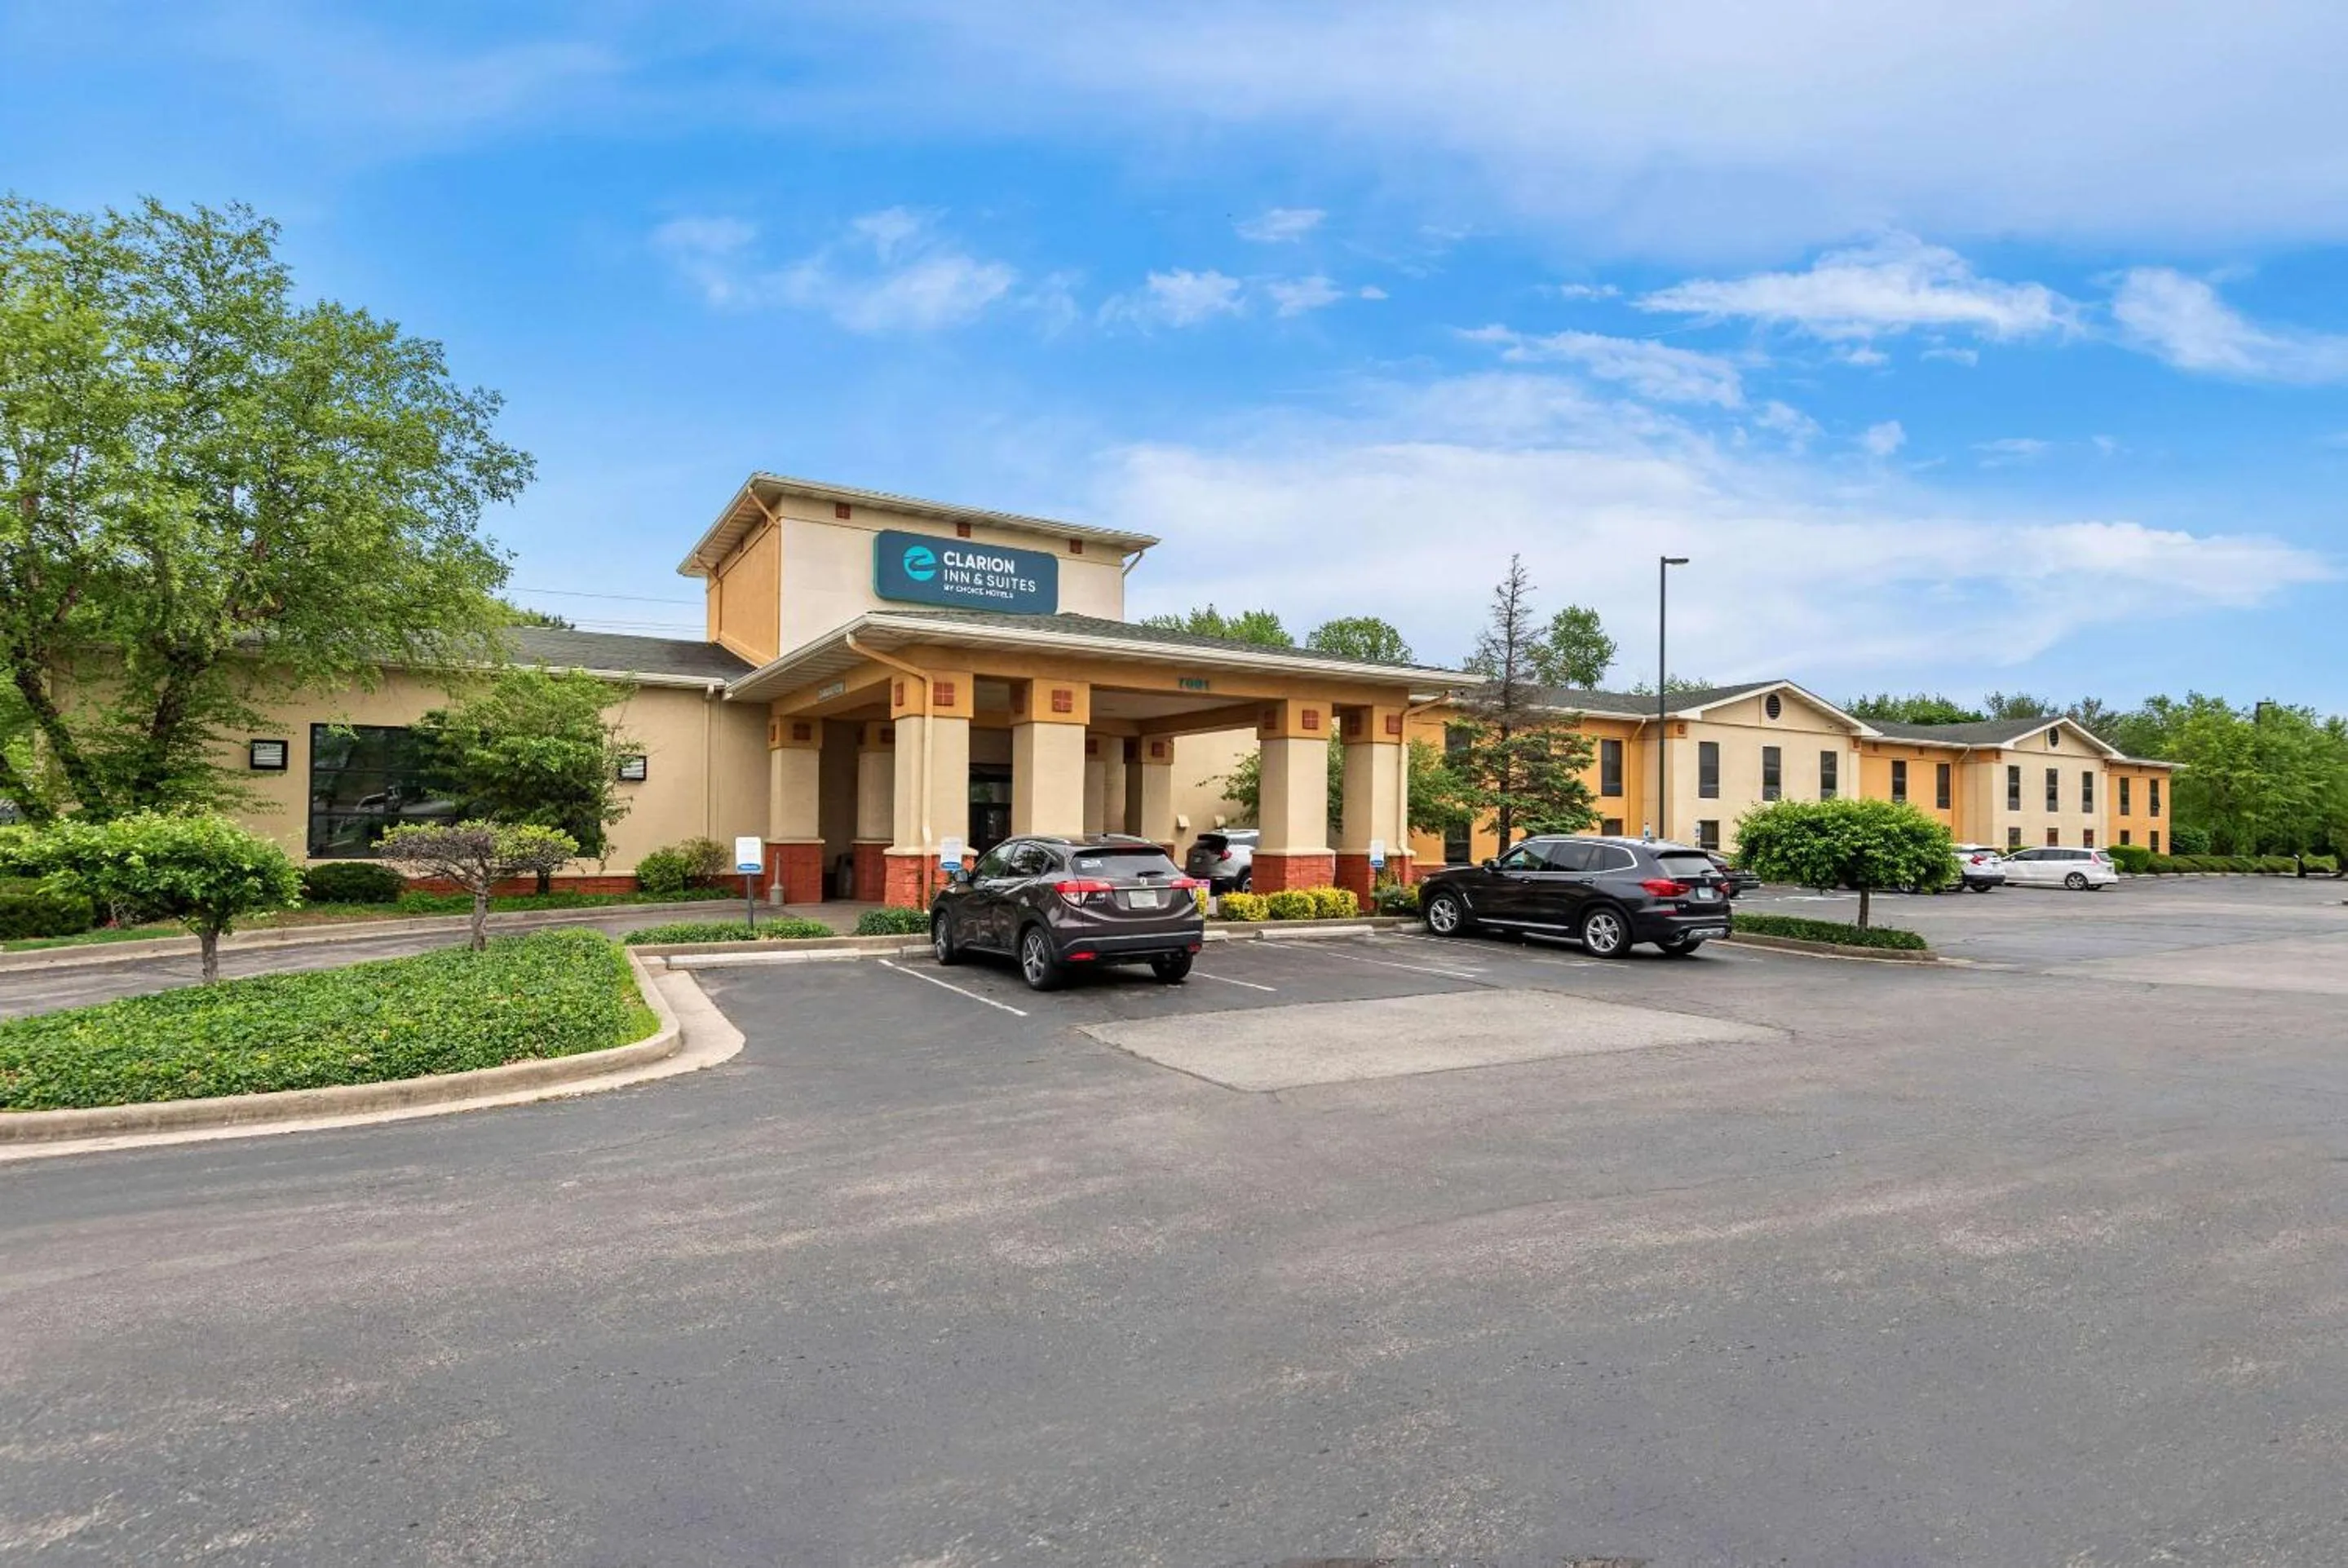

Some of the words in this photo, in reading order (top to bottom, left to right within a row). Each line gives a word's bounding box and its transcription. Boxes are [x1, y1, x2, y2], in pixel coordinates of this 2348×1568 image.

[944, 551, 1015, 574] CLARION
[944, 568, 970, 583] INN
[973, 572, 983, 585] &
[987, 574, 1036, 592] SUITES
